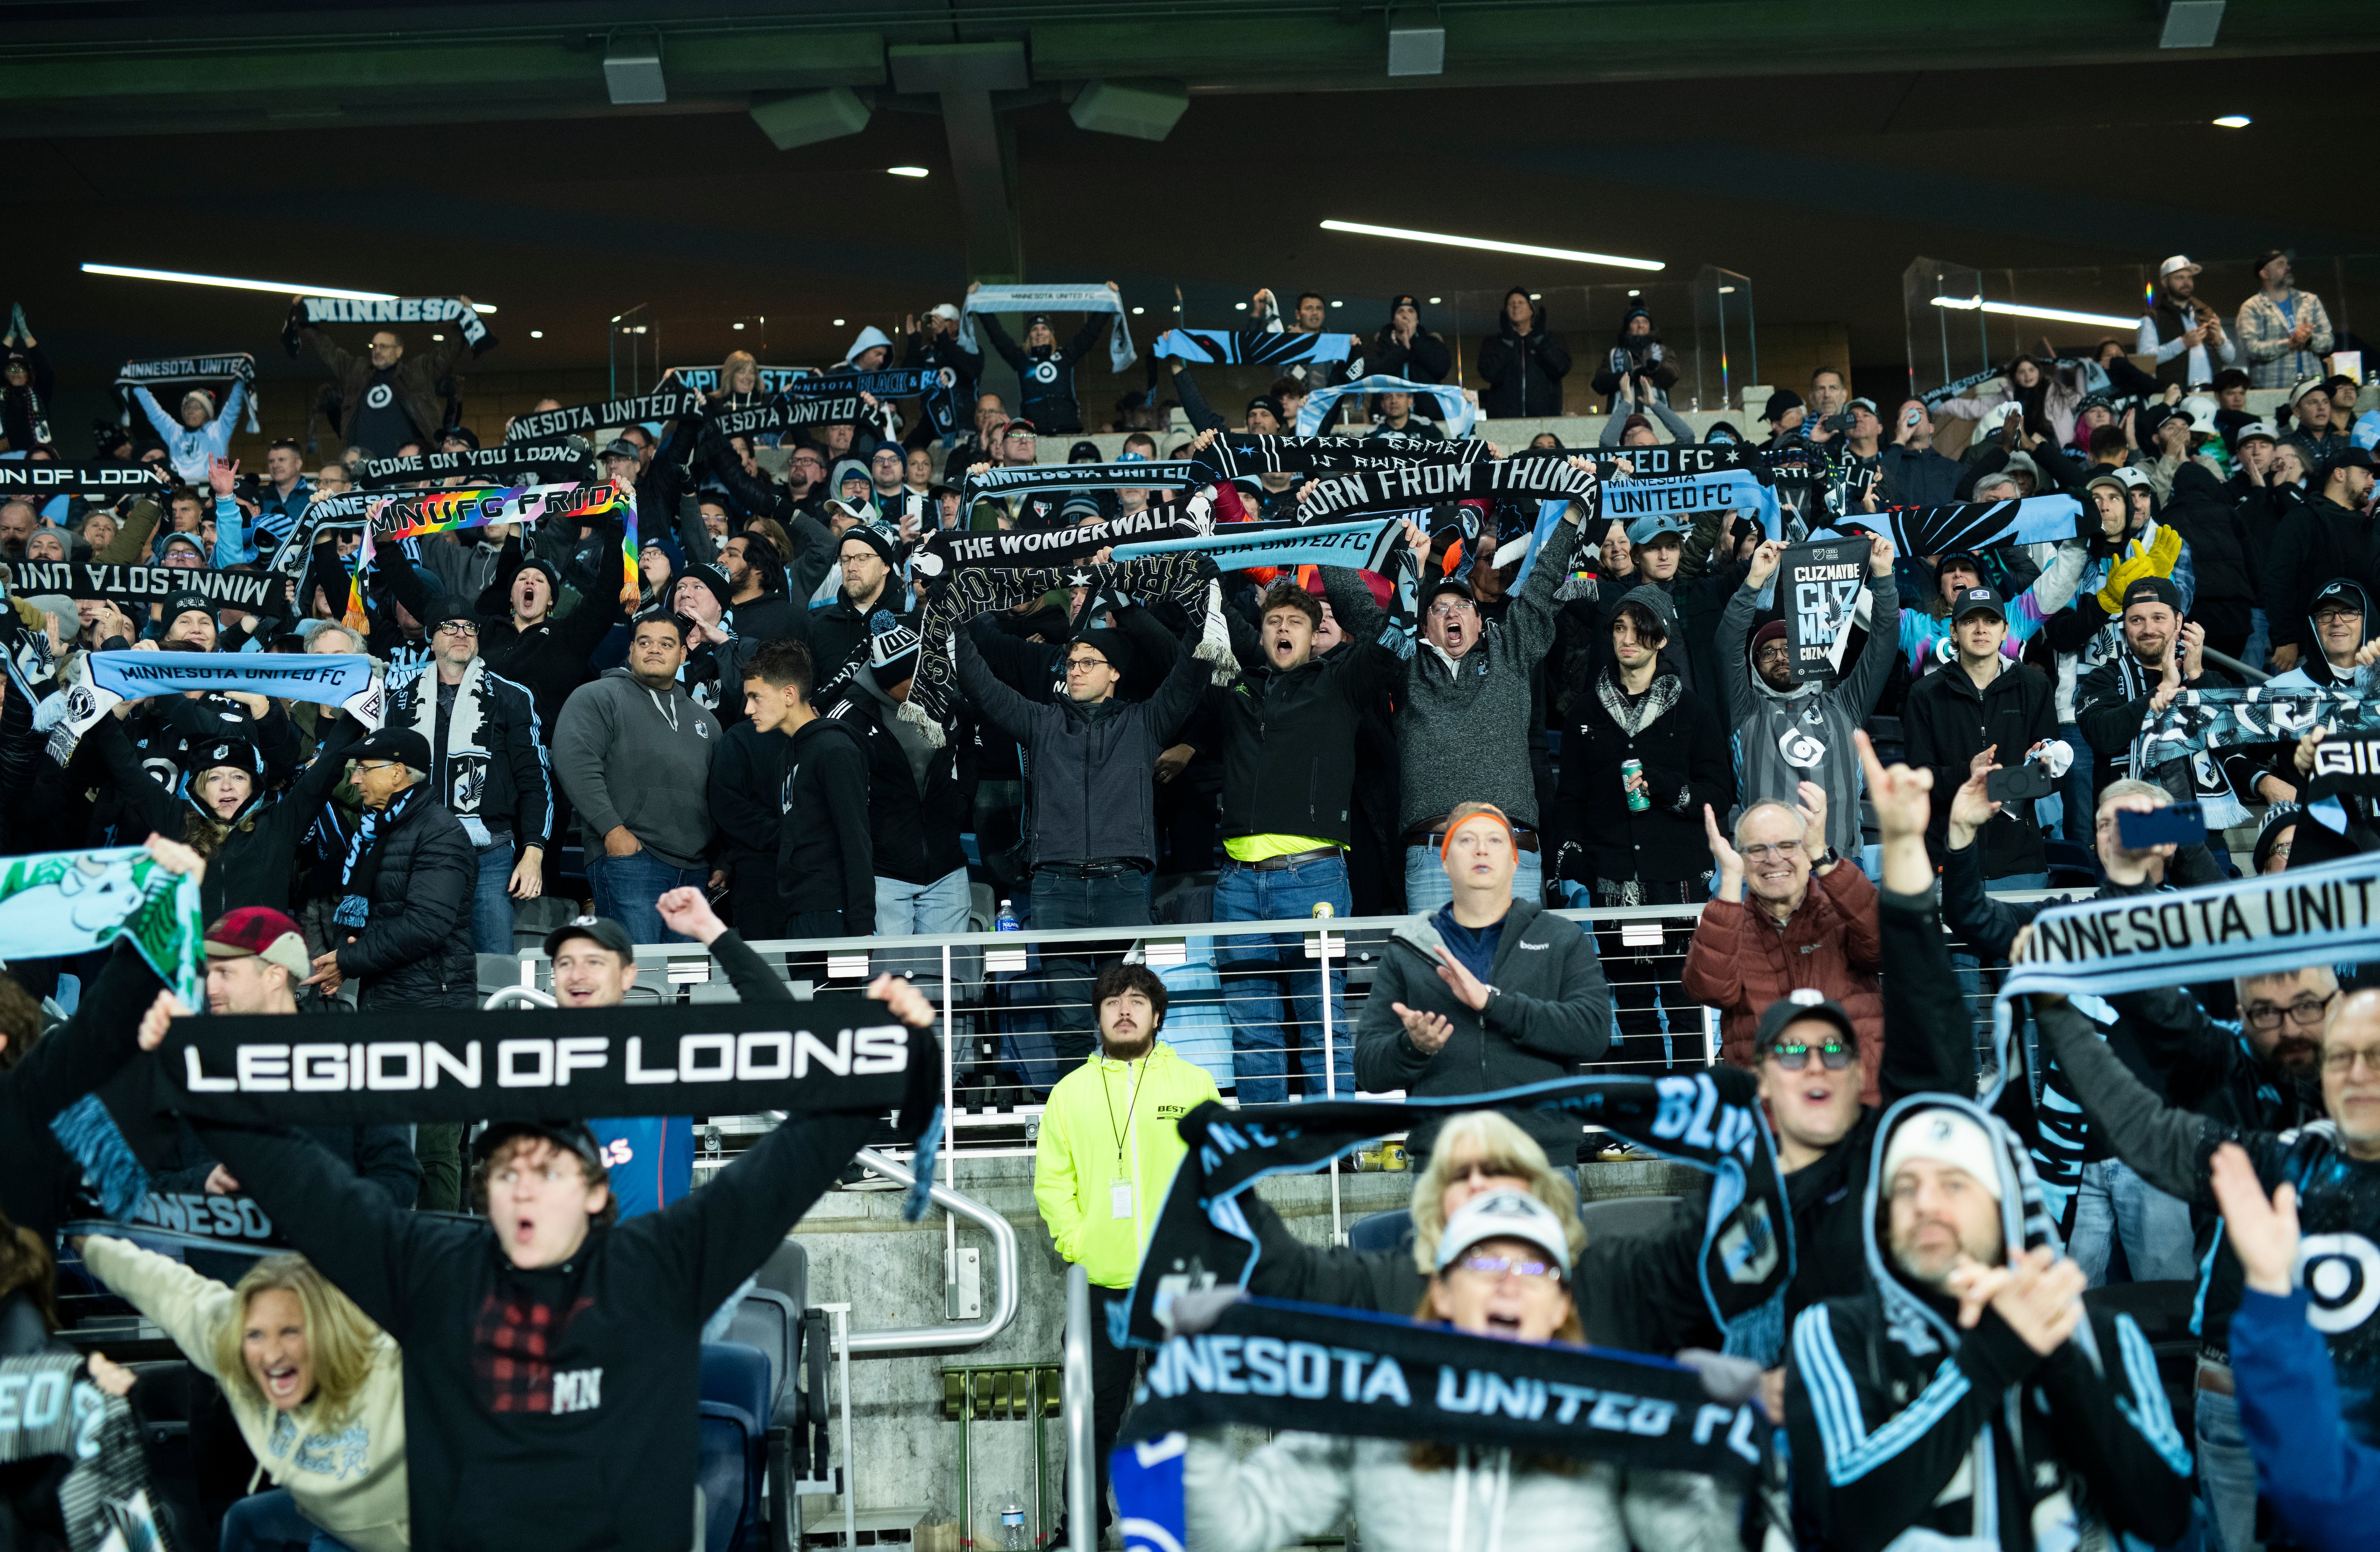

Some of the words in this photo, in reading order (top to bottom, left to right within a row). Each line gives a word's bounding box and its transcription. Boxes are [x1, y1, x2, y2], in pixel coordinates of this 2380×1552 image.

[304, 298, 486, 347] MINNESOTA
[120, 359, 196, 377] MINNESOTA
[857, 372, 909, 394] BLACK
[602, 394, 676, 424] UNITED
[787, 397, 857, 425] UNITED
[1279, 435, 1371, 449] EVERY
[1387, 437, 1463, 455] GAME
[367, 455, 424, 478] COME
[429, 452, 459, 469] ON
[466, 448, 507, 466] YOU
[514, 445, 581, 463] LOONS
[1310, 454, 1339, 468] IS
[1351, 455, 1428, 470] AWAY
[1679, 449, 1714, 471] FC
[32, 469, 74, 484] OF
[1378, 462, 1473, 500] FROM
[1611, 484, 1697, 514] UNITED
[1703, 483, 1733, 507] FC
[370, 496, 505, 537] MNUFC
[949, 536, 995, 562] THE
[1340, 533, 1371, 550] FC
[10, 563, 72, 590] UNI
[85, 564, 272, 606] MINNESOTA
[119, 666, 238, 681] MINNESOTA
[246, 669, 316, 681] UNITED
[319, 668, 346, 686] FC
[397, 691, 408, 710] STP
[2295, 719, 2314, 728] MNUFC
[2265, 875, 2377, 936] UNIT
[185, 1041, 482, 1093] LEGION
[497, 1036, 610, 1088] OF
[625, 1024, 909, 1085] LOONS
[1158, 1105, 1186, 1114] BEST
[551, 1367, 603, 1415] MN
[1437, 1364, 1677, 1437] UNITED
